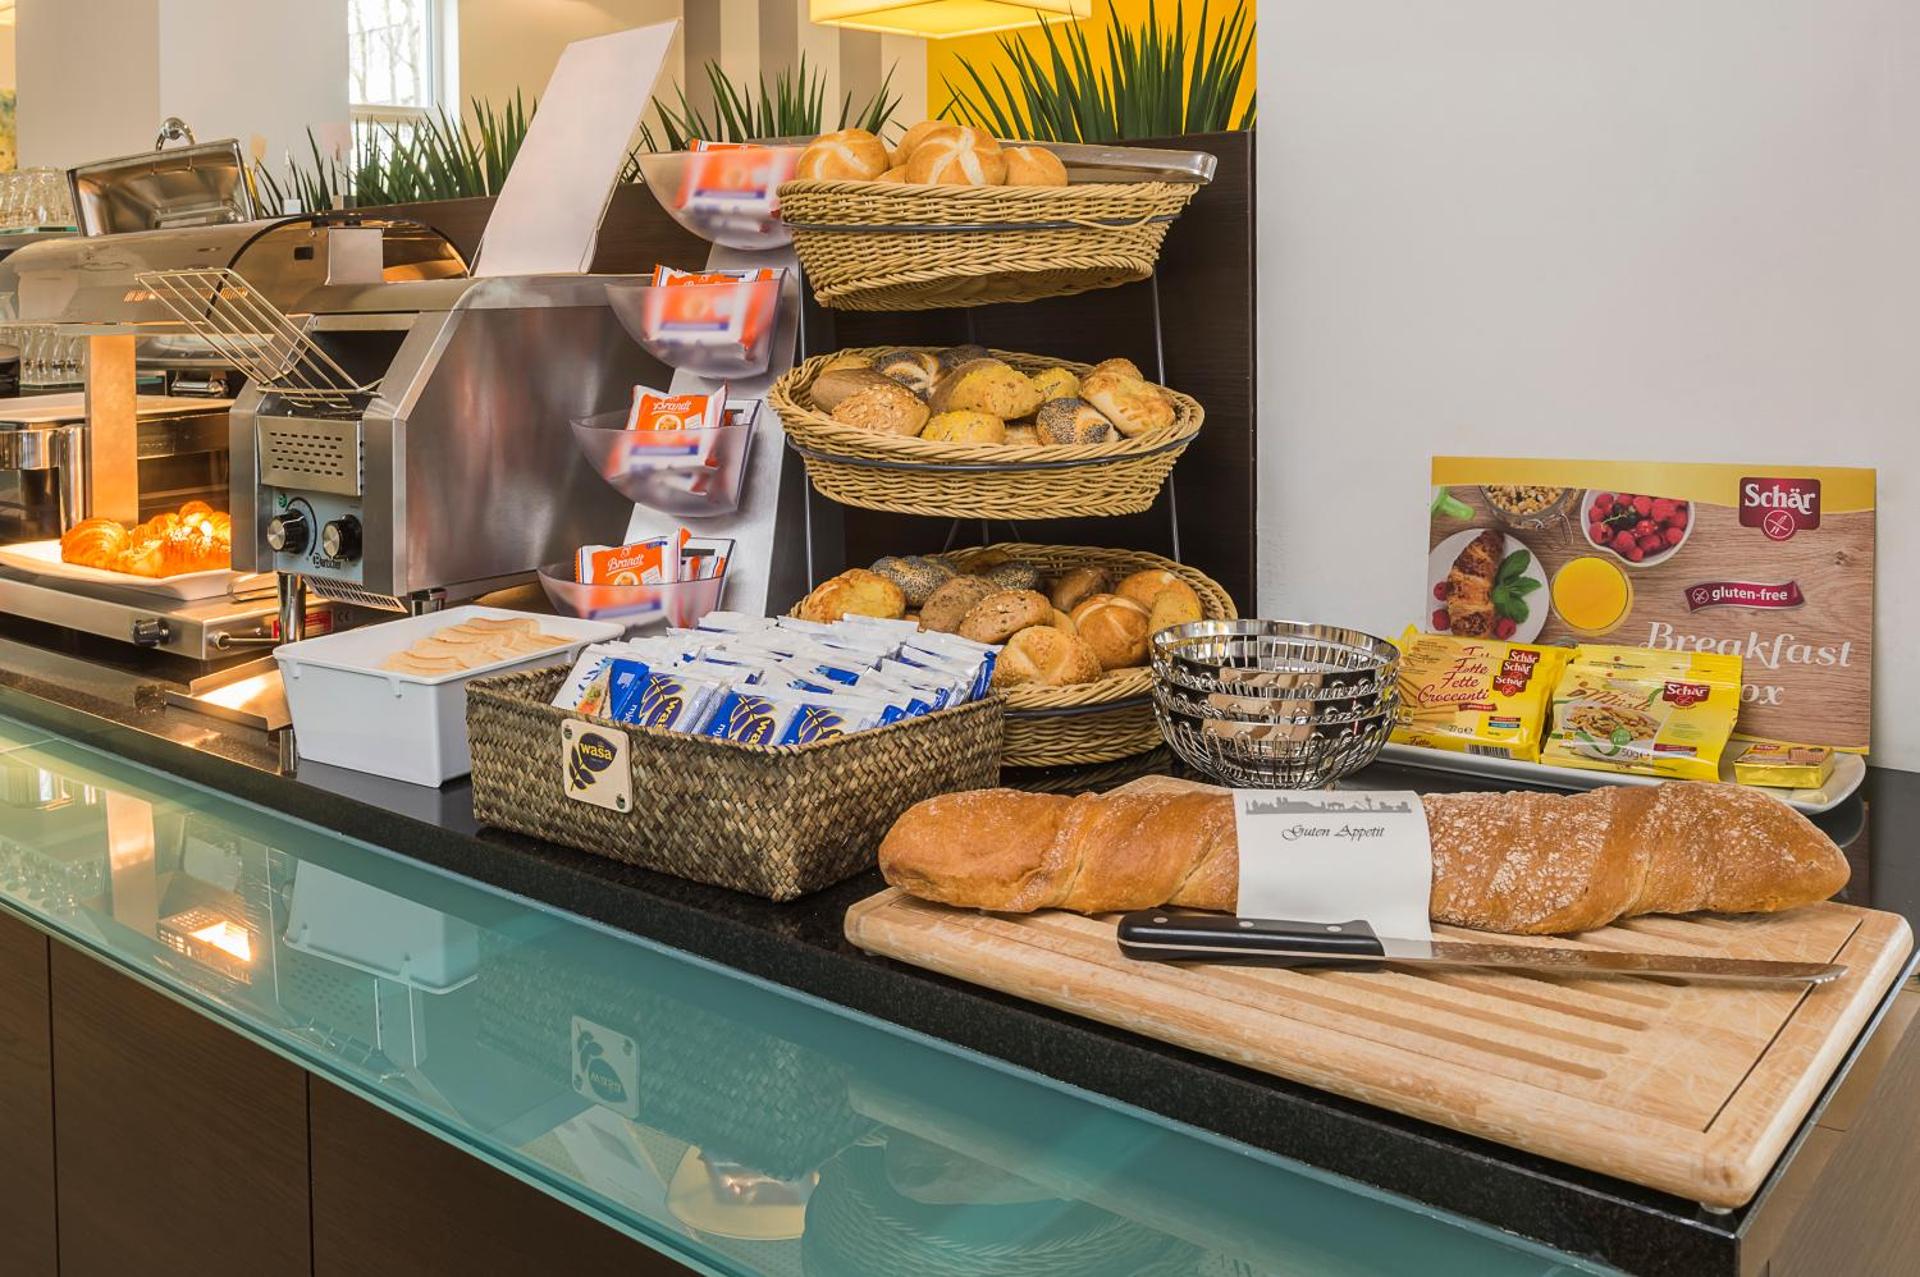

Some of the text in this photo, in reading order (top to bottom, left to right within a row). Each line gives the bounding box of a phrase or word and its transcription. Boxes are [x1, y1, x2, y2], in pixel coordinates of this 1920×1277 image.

[653, 400, 692, 411] Brandt
[1745, 483, 1816, 515] Schär
[608, 554, 645, 571] Brandt
[1712, 587, 1788, 602] gluten-free
[1639, 621, 1854, 669] Breakfast
[1417, 685, 1489, 704] Croccanti
[1741, 684, 1785, 706] ox
[580, 743, 613, 760] wasa
[1281, 825, 1385, 842] Guten Appetit
